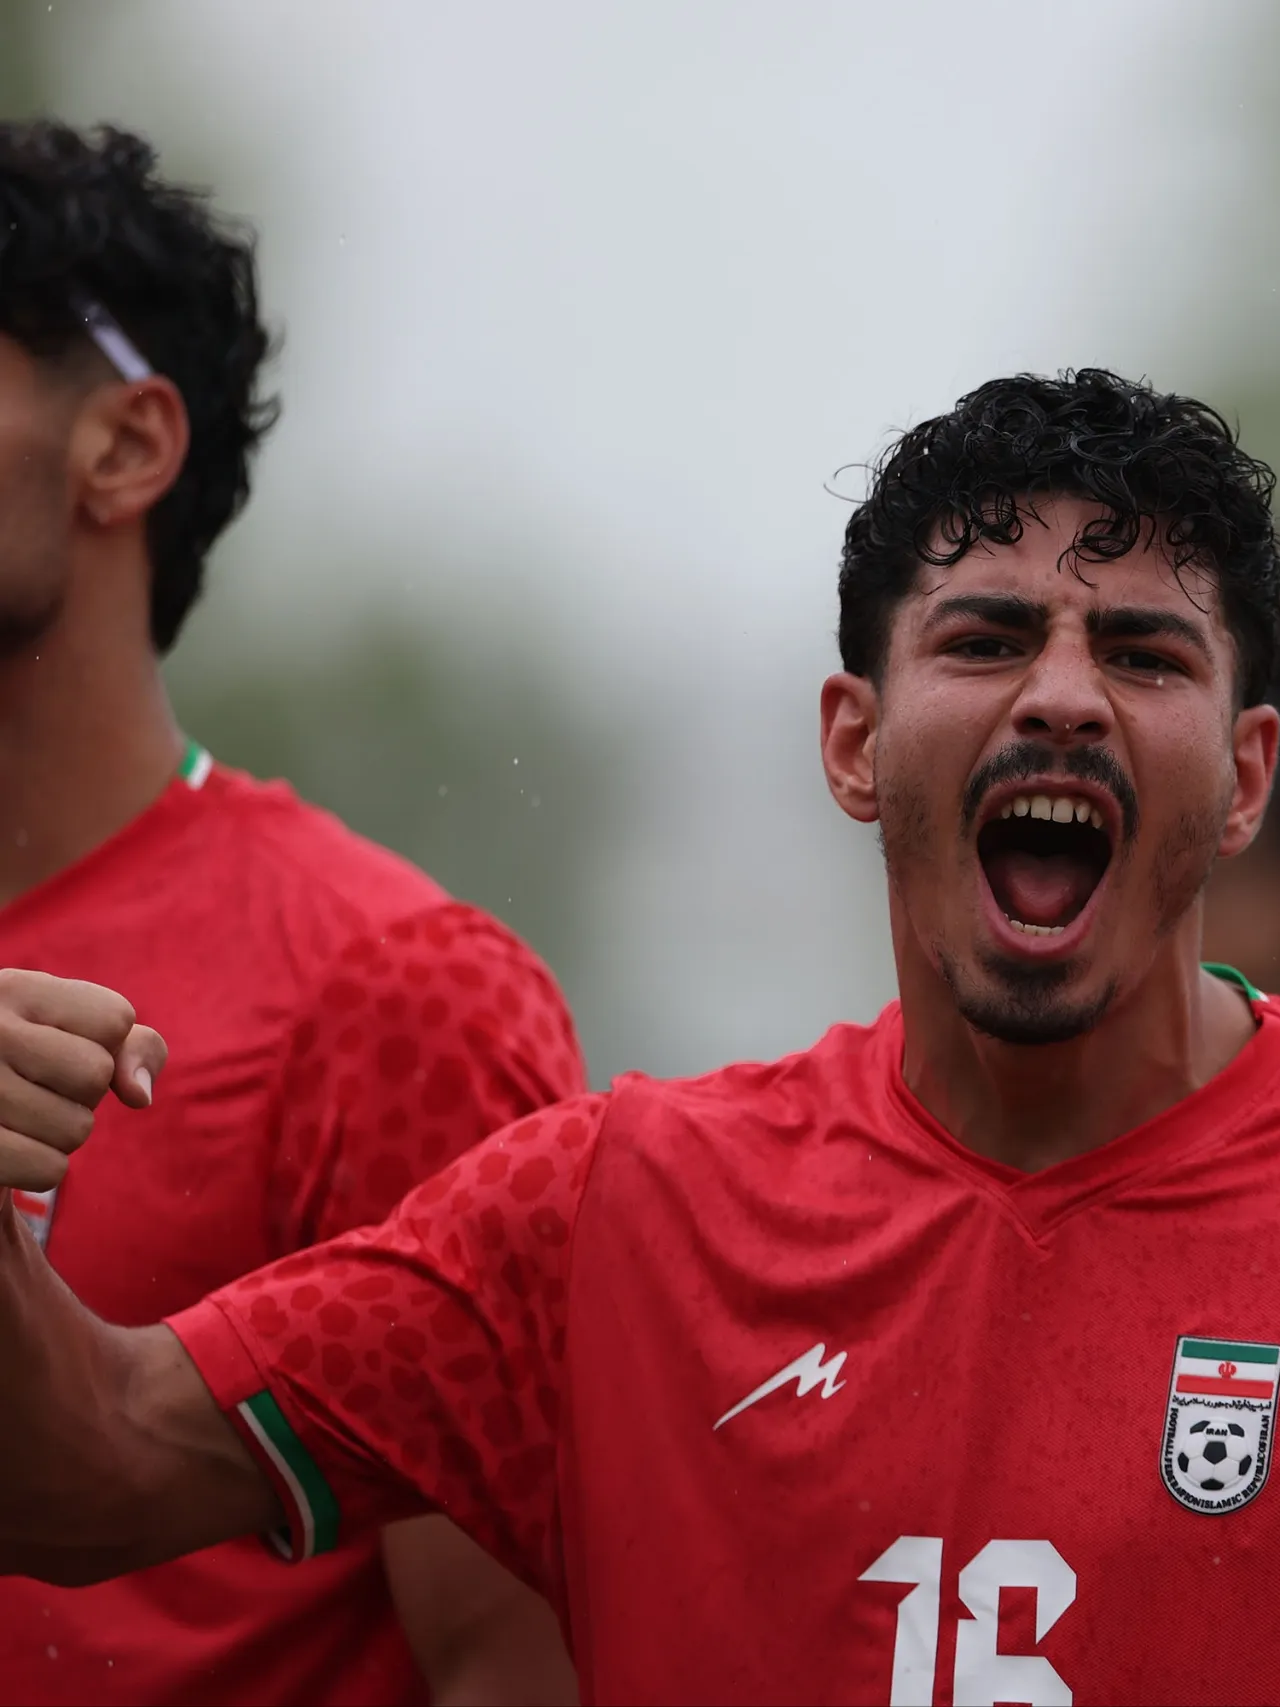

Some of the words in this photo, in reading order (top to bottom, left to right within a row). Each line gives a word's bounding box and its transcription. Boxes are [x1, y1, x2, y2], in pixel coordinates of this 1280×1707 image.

[1165, 1407, 1179, 1457] FOOTBALL
[1201, 1494, 1243, 1509] ISLAMIC
[1242, 1453, 1266, 1499] REPUBLIC
[1205, 1428, 1228, 1437] IRAN
[857, 1535, 1077, 1706] 16
